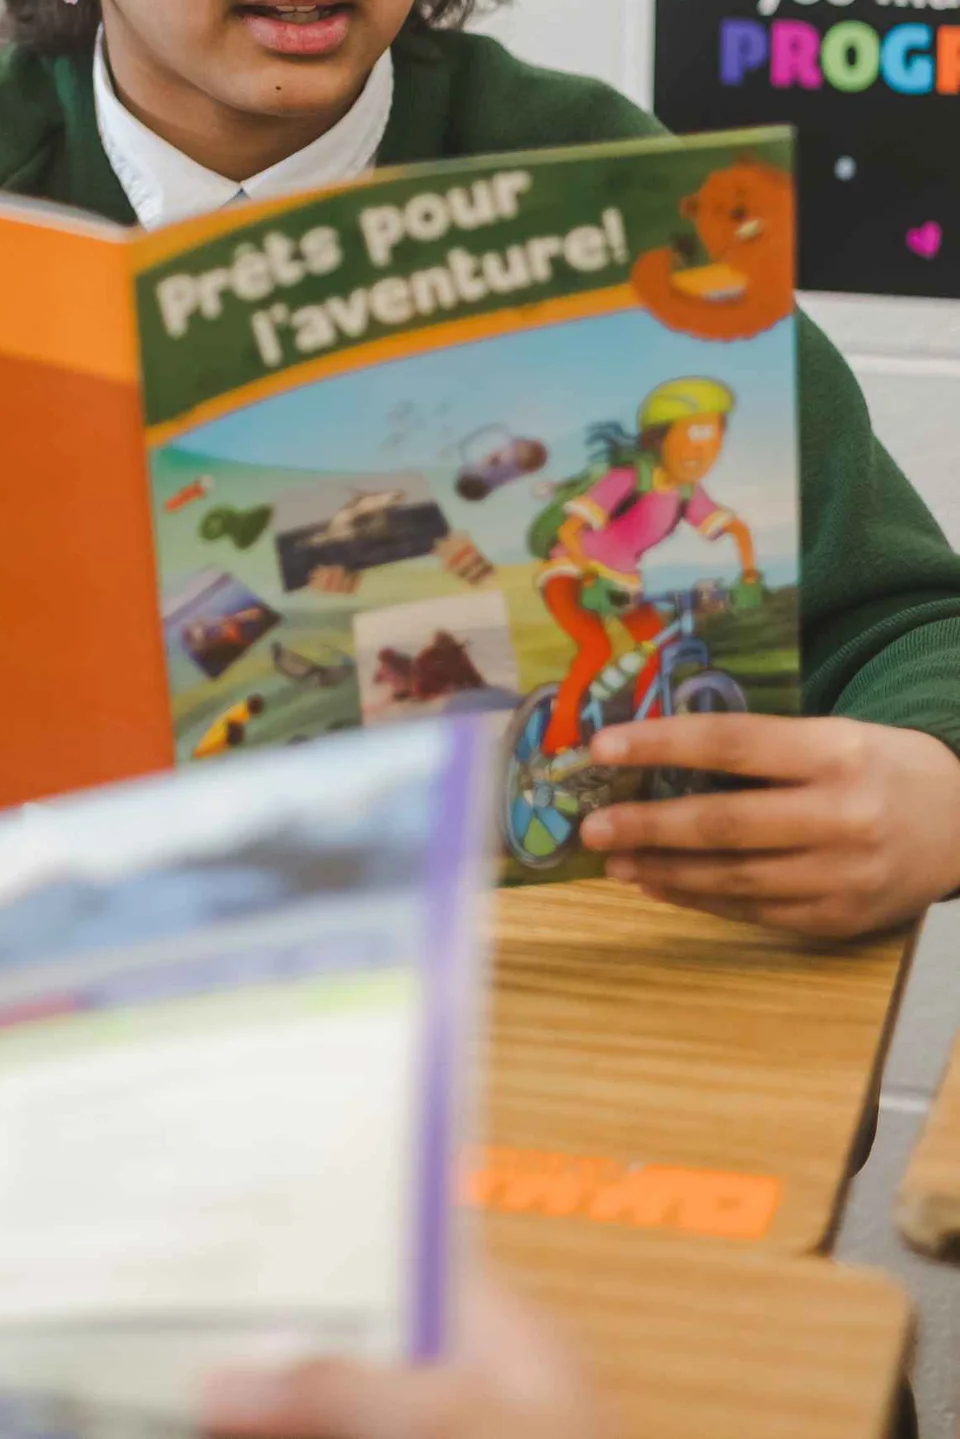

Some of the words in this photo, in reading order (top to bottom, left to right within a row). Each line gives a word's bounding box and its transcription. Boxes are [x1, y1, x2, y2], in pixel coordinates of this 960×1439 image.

[156, 224, 341, 338] Prêts
[358, 169, 532, 266] pour
[251, 206, 629, 366] l'aventure!
